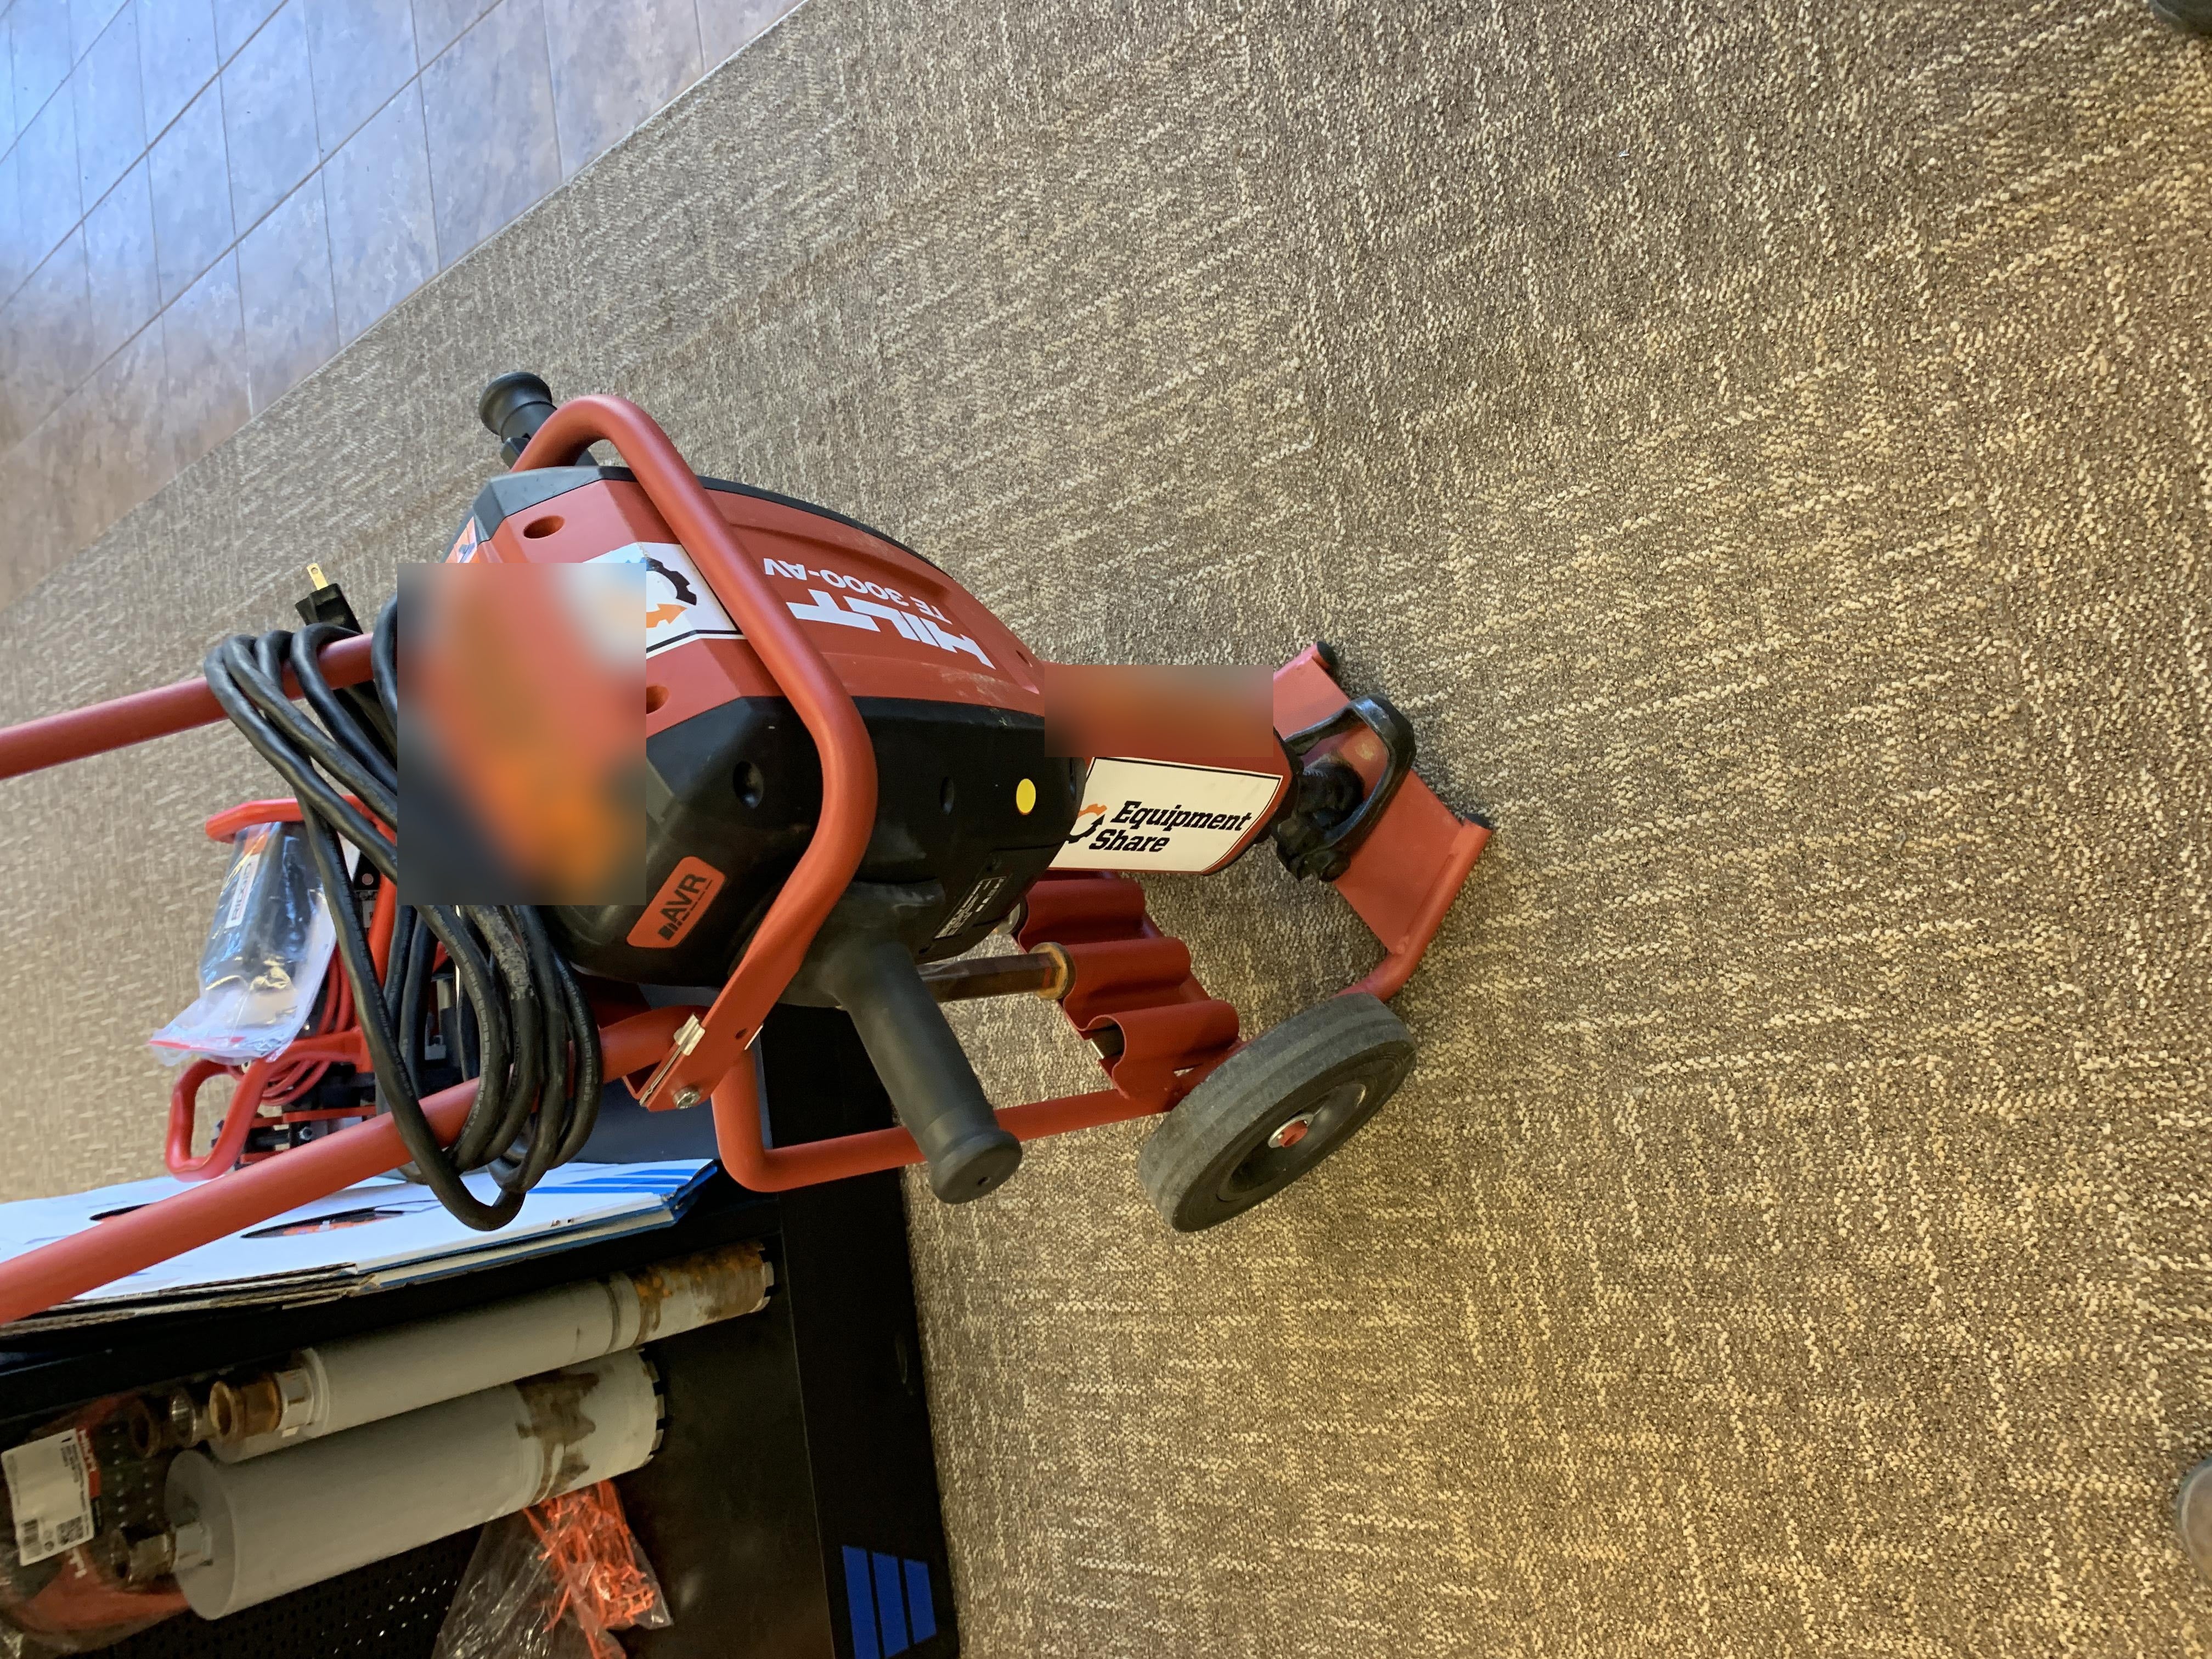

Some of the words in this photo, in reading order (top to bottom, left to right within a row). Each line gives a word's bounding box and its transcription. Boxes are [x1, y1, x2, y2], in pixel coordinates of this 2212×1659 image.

[763, 557, 910, 607] 3000-AV
[785, 588, 996, 670] HILT
[910, 596, 953, 625] TE
[1110, 800, 1252, 832] Equipment
[1088, 828, 1170, 852] Share
[660, 873, 707, 923] AVR
